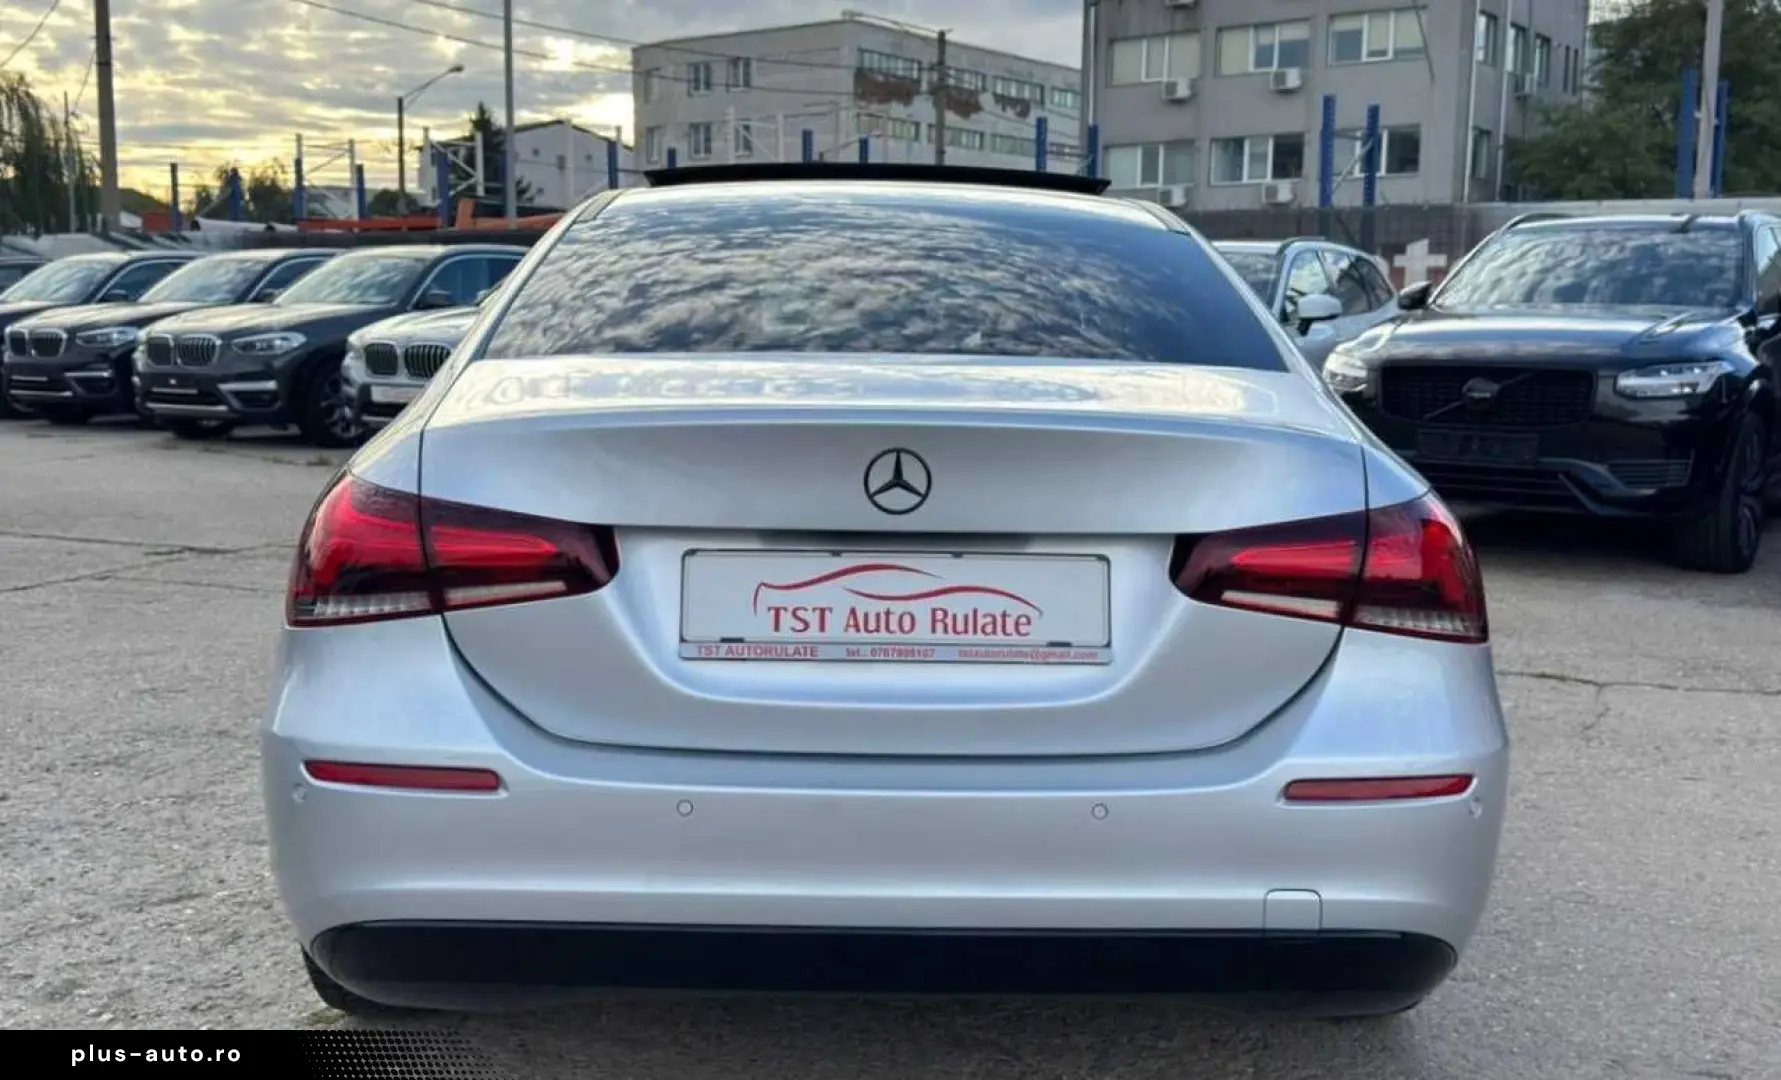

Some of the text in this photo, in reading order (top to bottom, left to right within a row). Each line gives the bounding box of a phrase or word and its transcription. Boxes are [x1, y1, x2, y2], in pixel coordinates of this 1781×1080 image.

[768, 606, 1032, 636] TST Auto Rulate
[697, 645, 720, 657] TST
[723, 645, 819, 658] AUTORULATE
